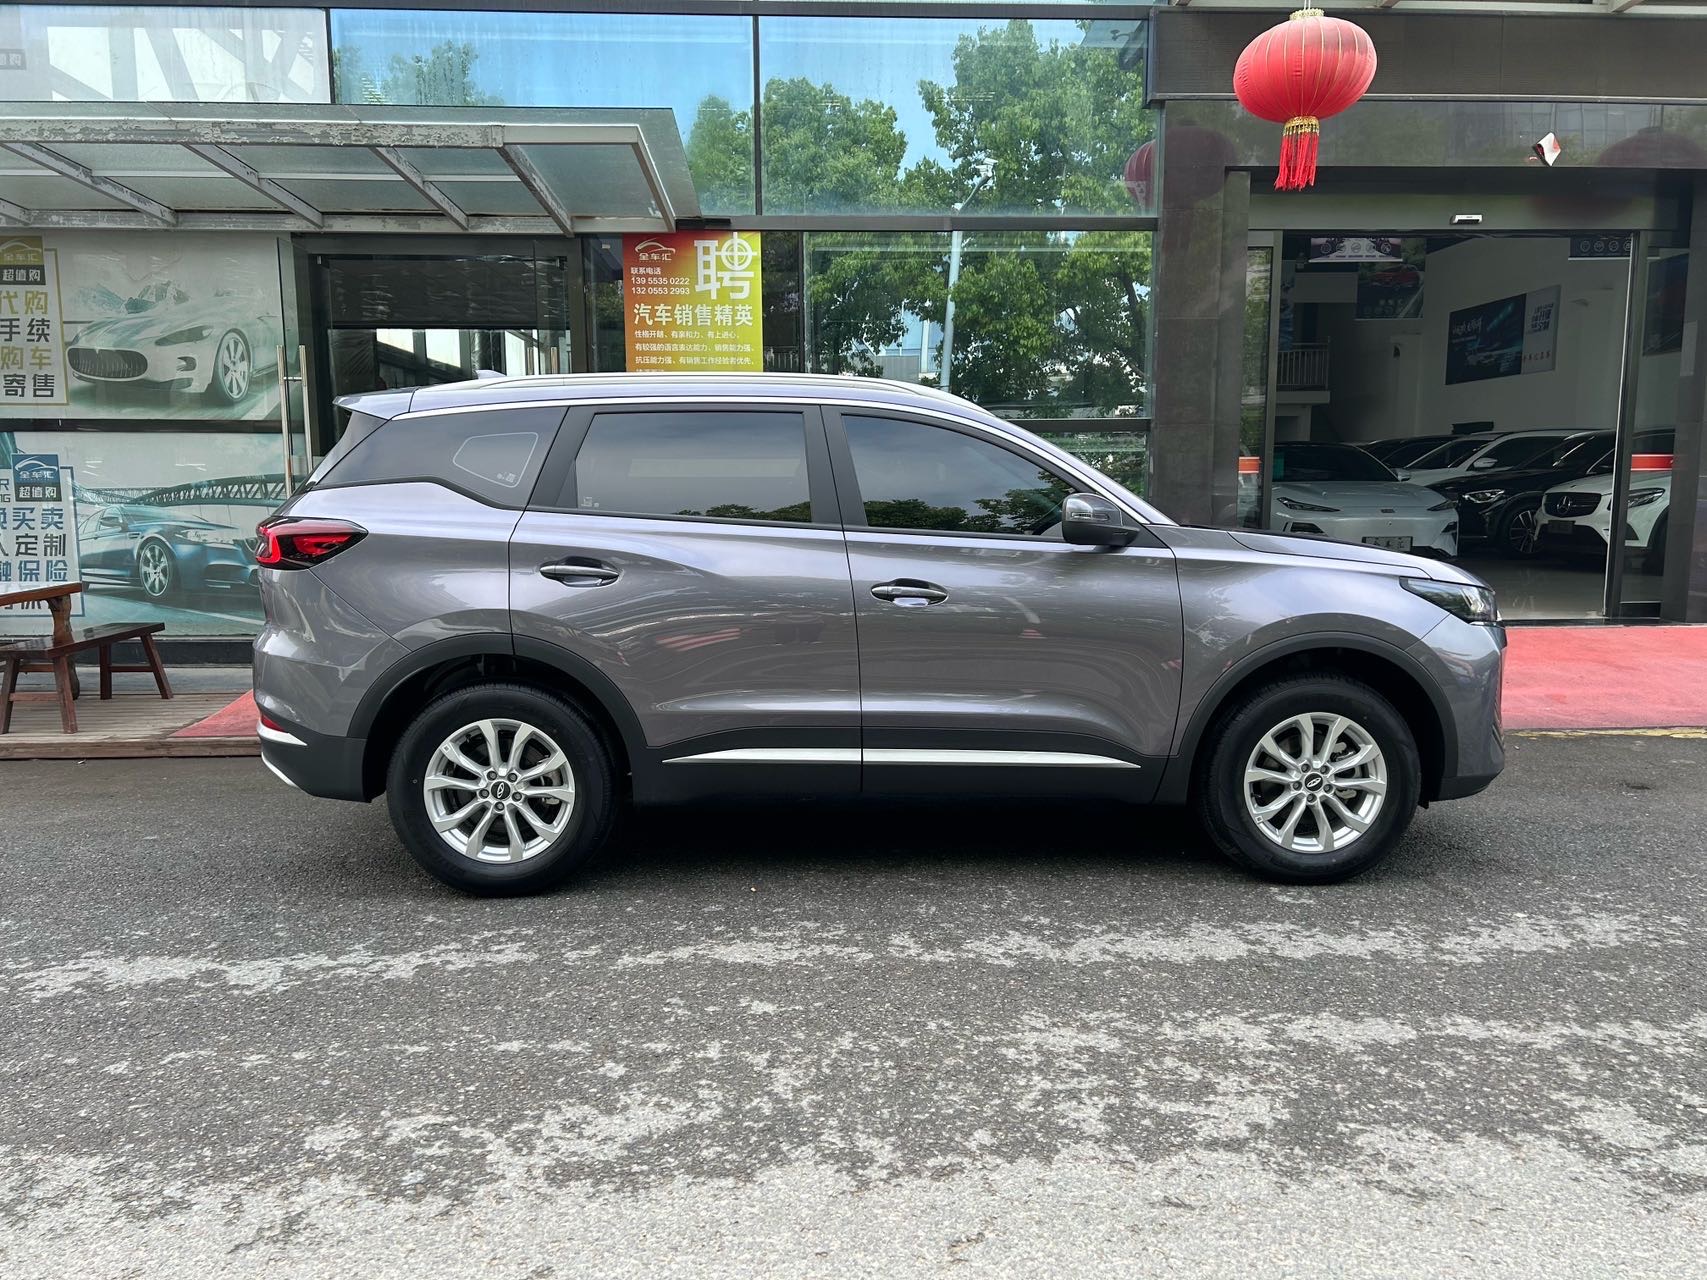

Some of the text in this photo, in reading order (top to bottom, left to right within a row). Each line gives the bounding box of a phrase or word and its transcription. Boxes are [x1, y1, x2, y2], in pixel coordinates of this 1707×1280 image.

[631, 267, 661, 275] 联系电话
[694, 232, 757, 300] 聘
[3, 269, 41, 281] 超值购
[632, 277, 690, 285] 139 5535 0222
[632, 287, 690, 295] 132 0553 2993
[634, 303, 753, 326] 汽车销售精英
[0, 317, 50, 342] 手续
[1, 346, 52, 370] 购车
[3, 373, 55, 397] 寄售
[19, 486, 57, 498] 超值购
